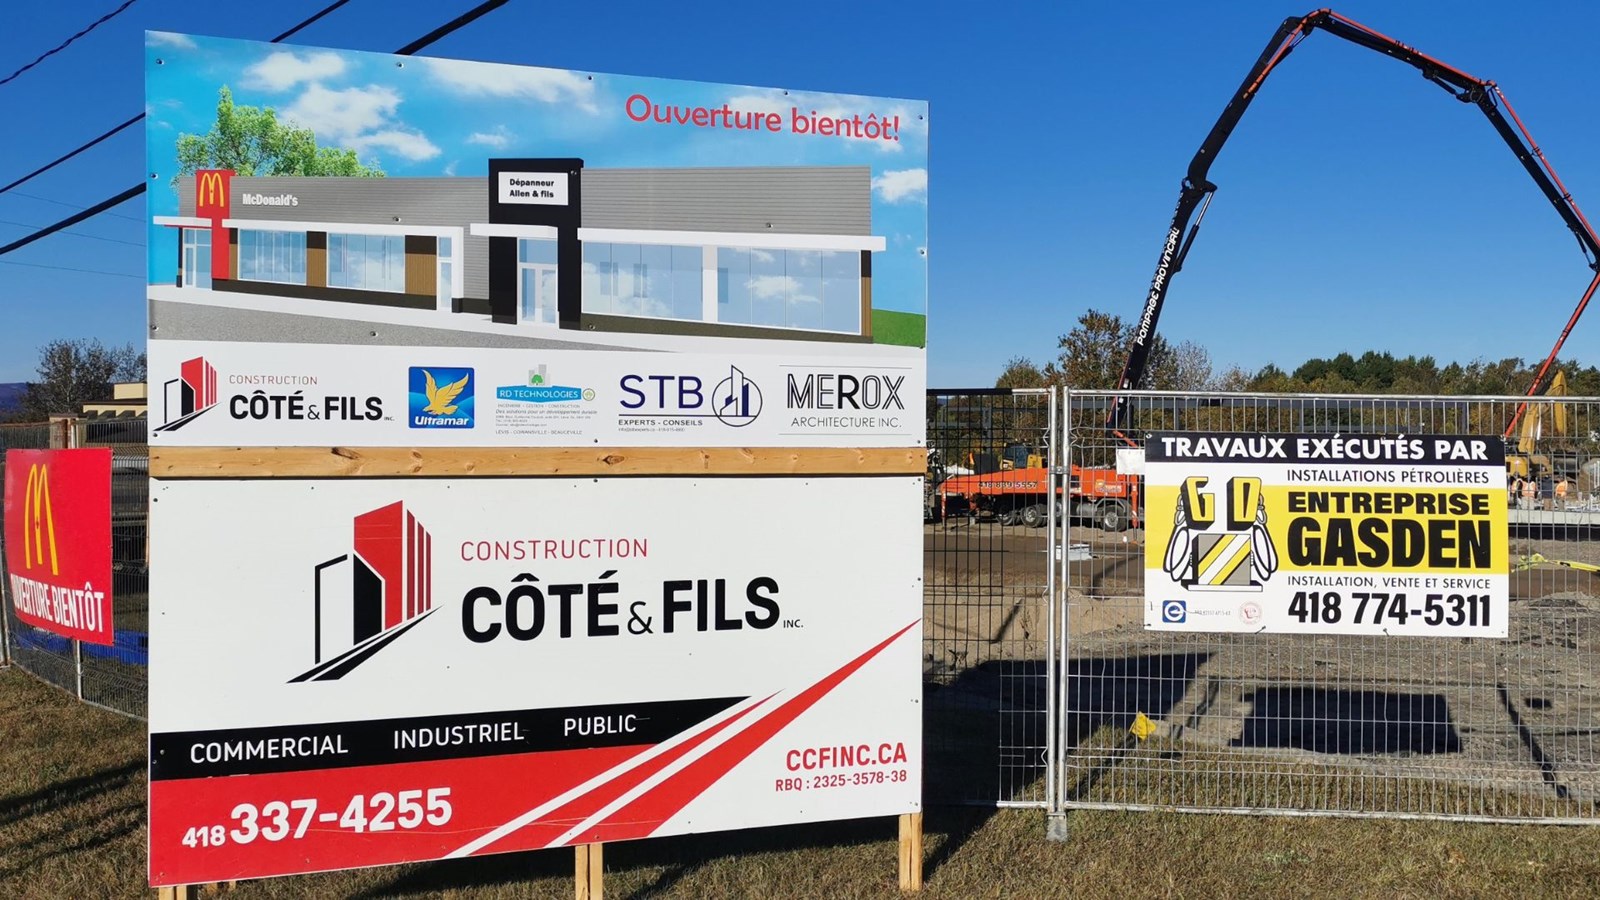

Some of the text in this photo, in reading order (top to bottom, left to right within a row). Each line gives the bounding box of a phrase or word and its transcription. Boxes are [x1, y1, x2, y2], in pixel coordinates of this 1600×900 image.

[625, 94, 900, 141] Ouverture bientôt!
[509, 177, 554, 189] Dépanneur
[509, 189, 554, 198] Allen & fils
[242, 193, 298, 207] McDonald's
[1136, 227, 1180, 346] POMPAGE PROVINCIAL
[229, 374, 318, 386] CONSTRUCTION
[514, 390, 578, 398] TECHNOLOGIES
[619, 374, 704, 409] STB
[787, 373, 905, 410] MEROX
[229, 389, 304, 421] CÔTÉ
[307, 404, 320, 420] &
[324, 396, 383, 421] FILS
[415, 415, 470, 427] Ultramar
[791, 416, 902, 428] ARCHITECTURE INC.
[1161, 433, 1488, 461] TRAVAUX EXÉCUTÉS PAR
[1287, 466, 1489, 484] INSTALLATIONS PÉTROLIÈRES
[1288, 492, 1490, 515] ENTREPRISE
[460, 538, 648, 561] CONSTRUCTION
[1287, 516, 1492, 569] GASDEN
[1288, 576, 1491, 590] INSTALLATION, VENTE ET SERVICE
[51, 581, 104, 633] BIENTÔT
[461, 570, 804, 643] CÔTÉ & FILS INC.
[1288, 591, 1342, 624] 418
[1351, 592, 1490, 627] 774-5311
[190, 714, 637, 764] COMMERCIAL INDUSTRIEL PUBLIC
[786, 742, 907, 771] CCFINC.CA
[775, 777, 802, 792] RBQ
[813, 769, 907, 789] 2325-3578-38
[182, 787, 453, 849] 418 337-4255
